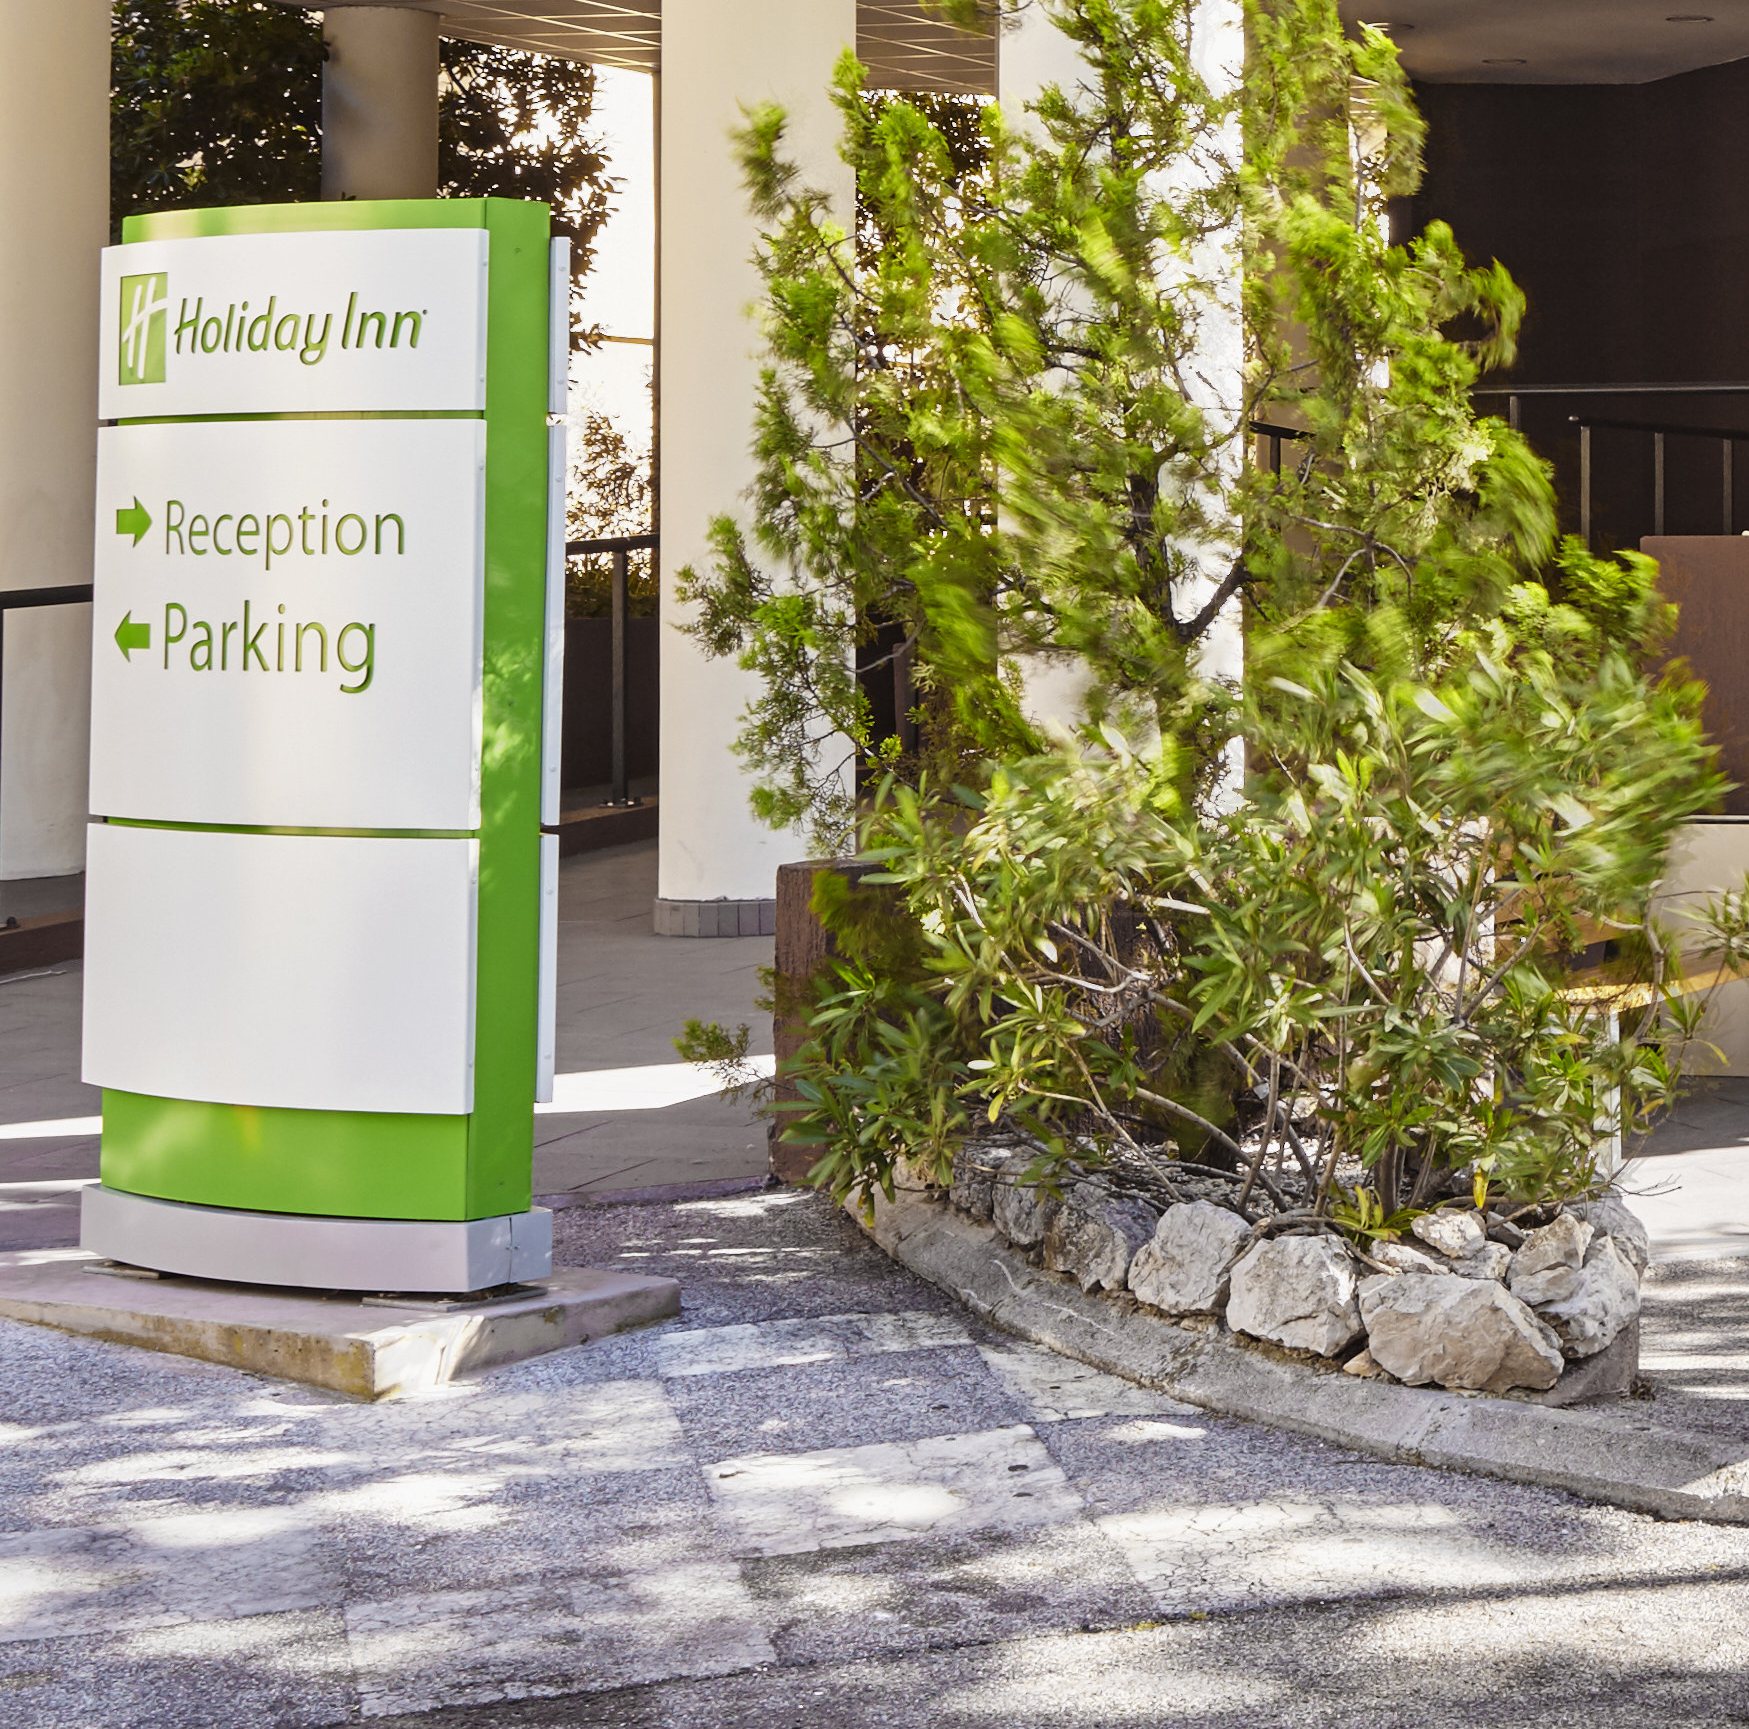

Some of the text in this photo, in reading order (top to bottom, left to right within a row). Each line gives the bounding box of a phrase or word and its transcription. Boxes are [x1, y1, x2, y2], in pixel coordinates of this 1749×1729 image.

[174, 291, 423, 366] Holiday Inn
[165, 499, 405, 571] Reception
[164, 600, 375, 694] Parking
